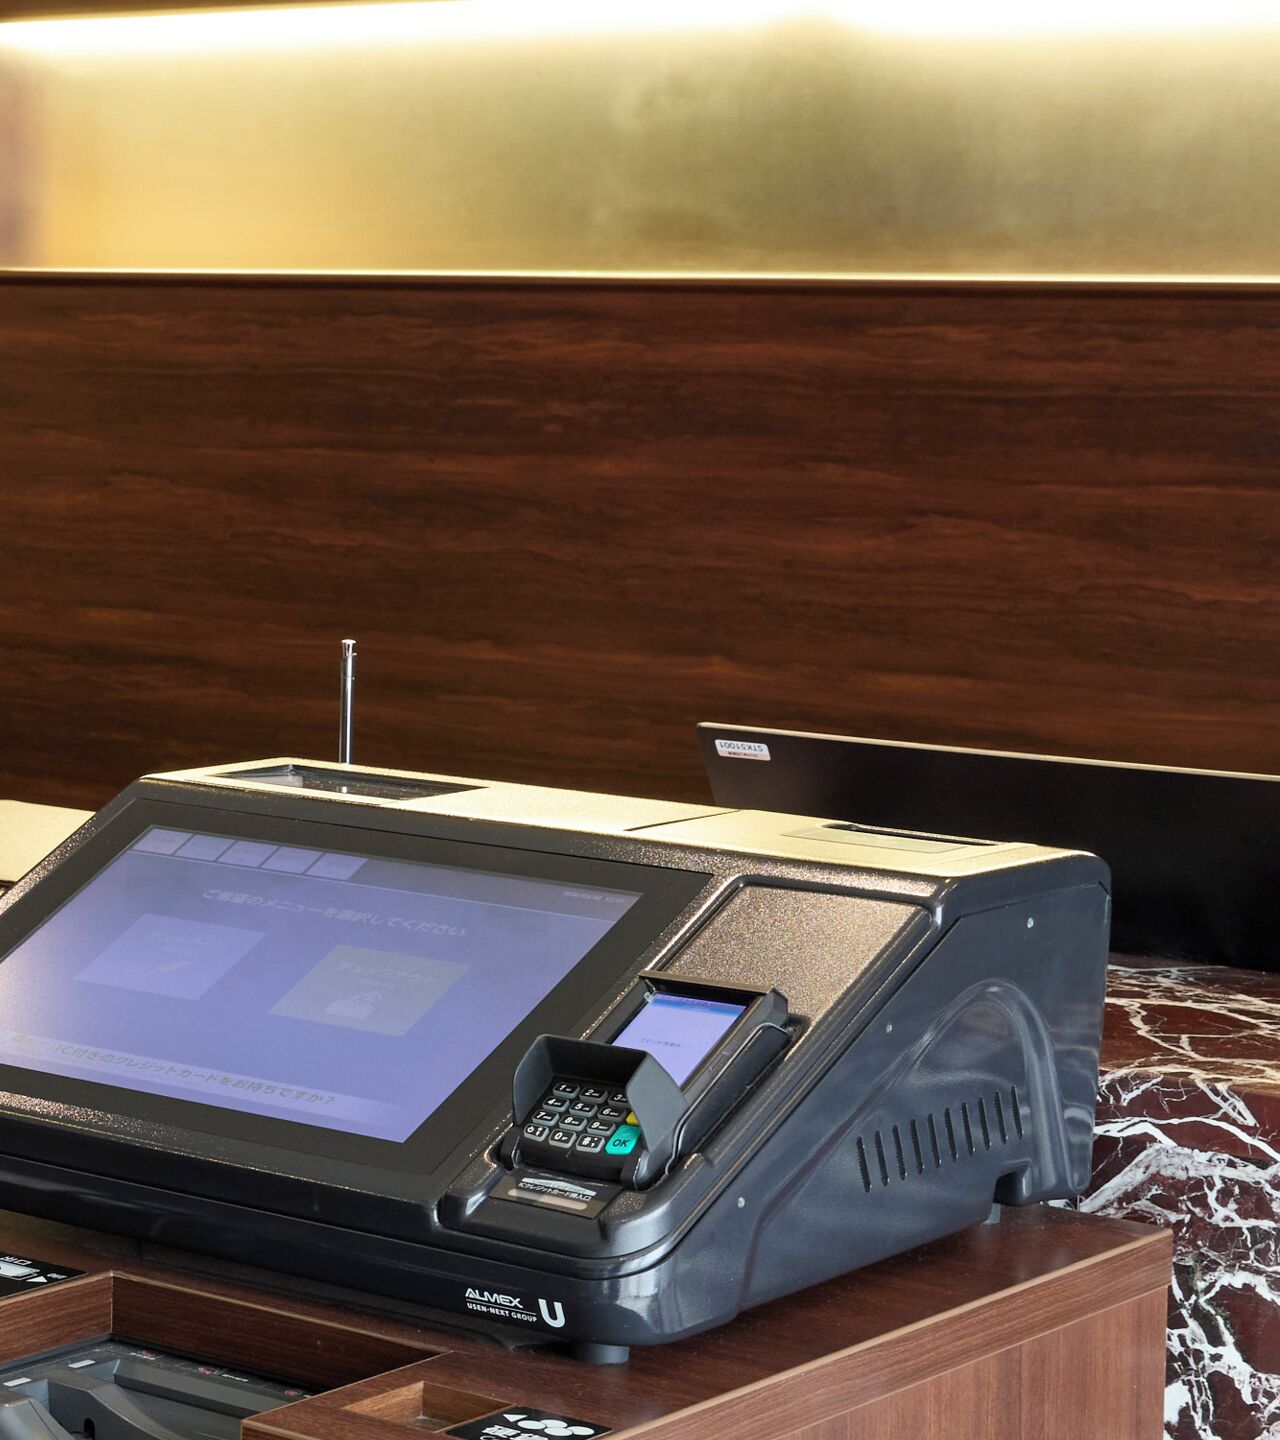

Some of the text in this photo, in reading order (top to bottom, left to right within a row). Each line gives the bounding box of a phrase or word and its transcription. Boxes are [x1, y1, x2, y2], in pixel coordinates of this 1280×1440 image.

[612, 1139, 630, 1147] OK
[465, 1287, 566, 1328] ALMEX U
[466, 1302, 538, 1323] USEN-NEXT GROUP
